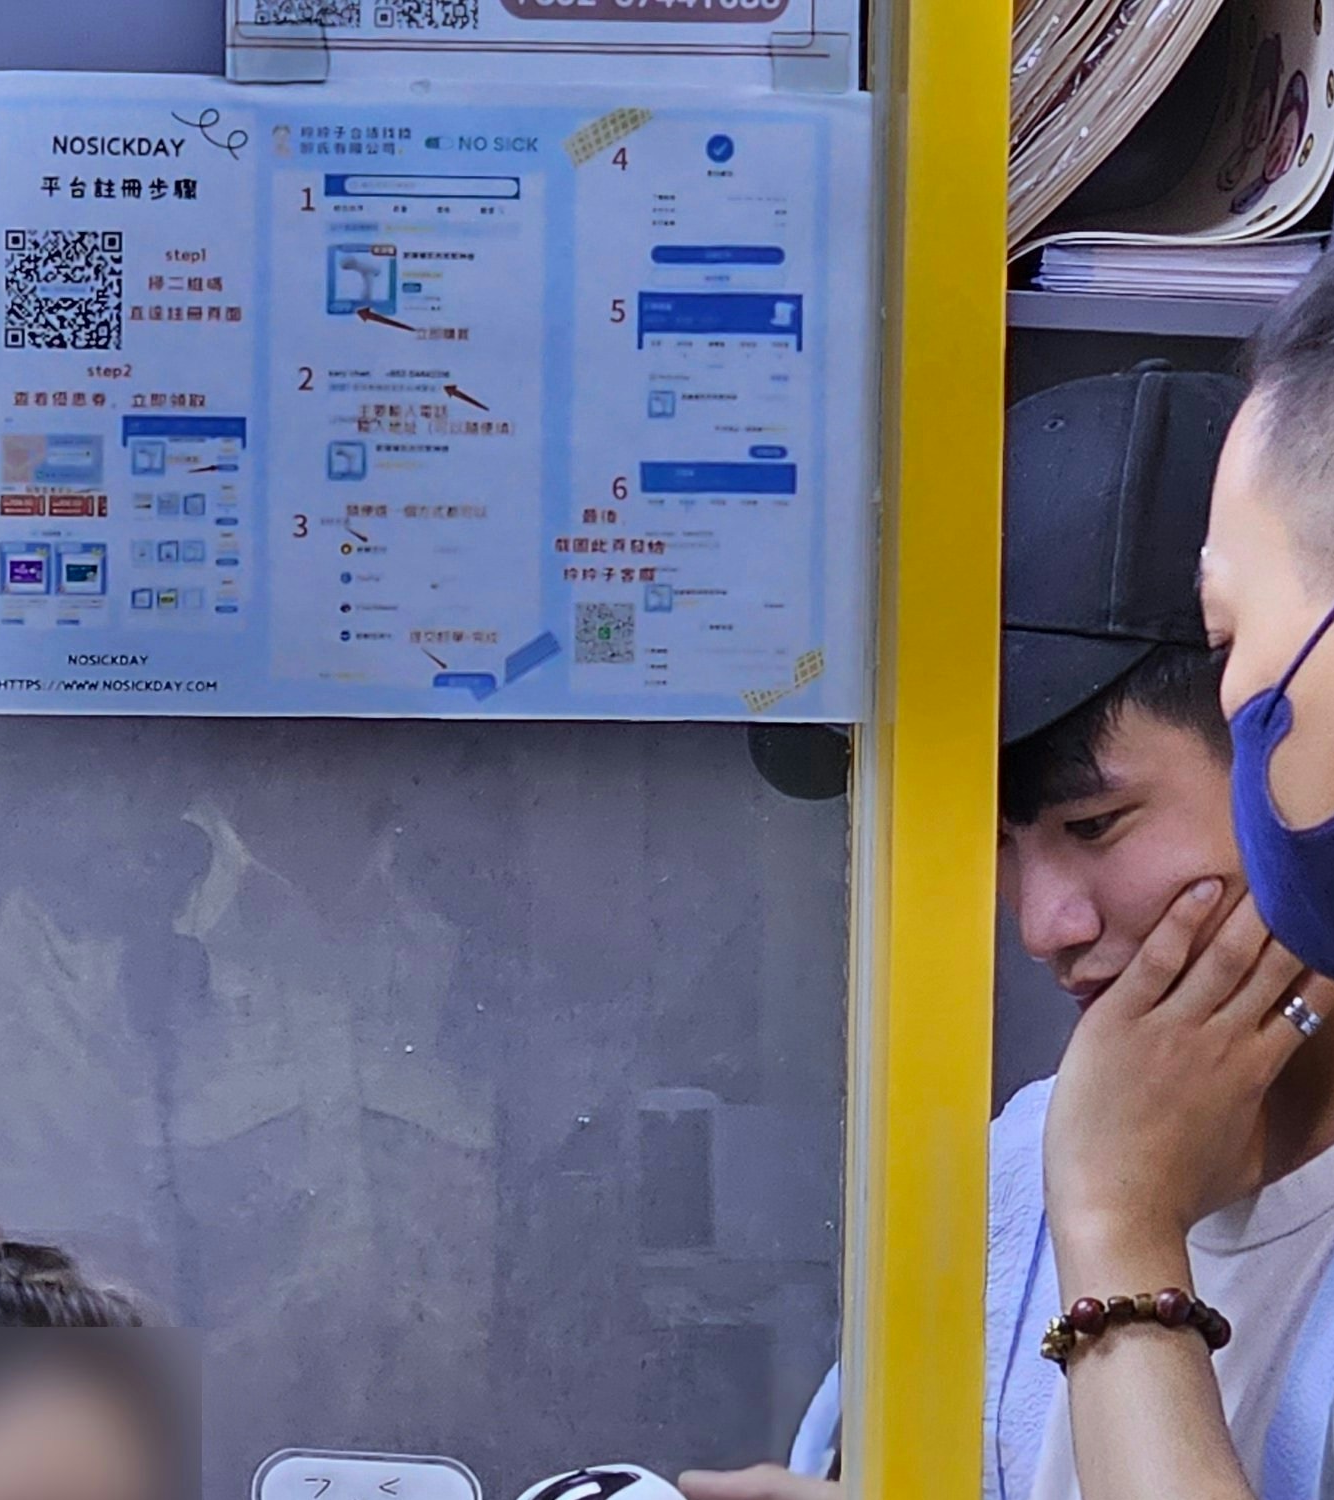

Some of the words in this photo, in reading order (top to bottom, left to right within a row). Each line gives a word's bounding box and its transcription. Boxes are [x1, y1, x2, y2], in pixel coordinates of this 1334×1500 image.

[52, 136, 186, 157] NOSICKDAY
[458, 136, 488, 151] NO
[493, 137, 539, 152] SICK
[611, 147, 628, 171] 4
[40, 176, 197, 200] 平台註冊步驟
[300, 187, 315, 211] 1
[165, 247, 207, 264] step1
[610, 299, 626, 323] 5
[87, 364, 133, 379] step2
[298, 366, 314, 391] 2
[612, 476, 628, 501] 6
[292, 514, 308, 538] 3
[68, 655, 149, 666] NOSICKDAY
